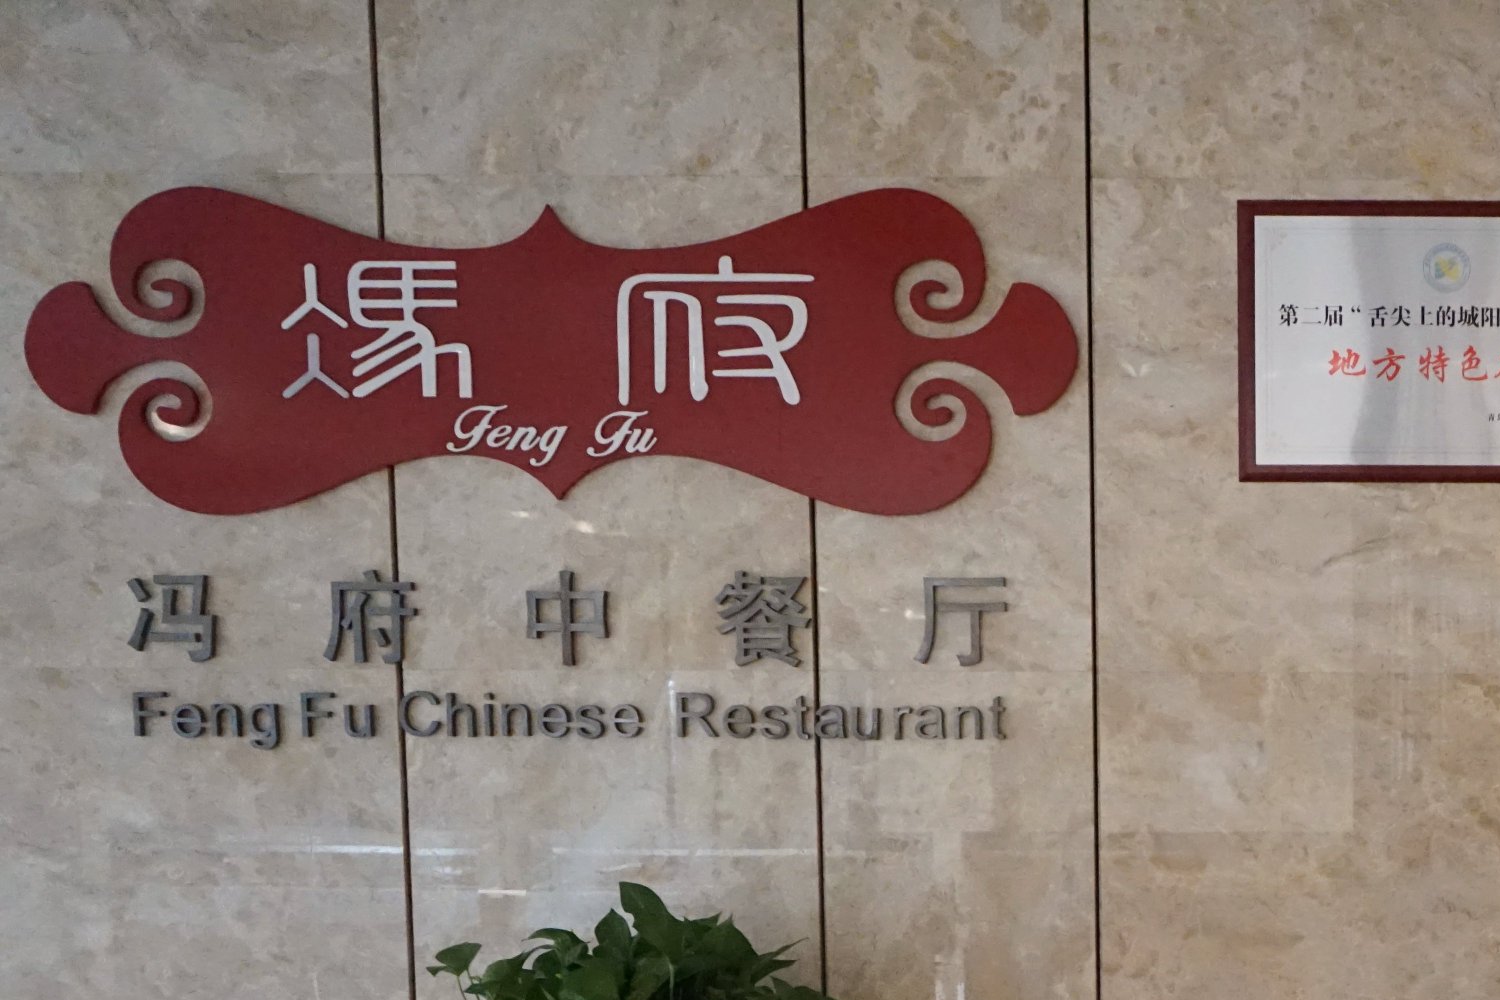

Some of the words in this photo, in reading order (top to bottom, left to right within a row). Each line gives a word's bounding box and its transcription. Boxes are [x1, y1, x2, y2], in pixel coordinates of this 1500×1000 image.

[446, 405, 568, 467] Feng
[586, 410, 658, 457] Fu
[127, 568, 1009, 668] 冯府中餐厅
[132, 690, 281, 750] Feng
[300, 690, 376, 739] Fu
[400, 689, 645, 740] Chinese
[675, 691, 1007, 741] Restaurant
